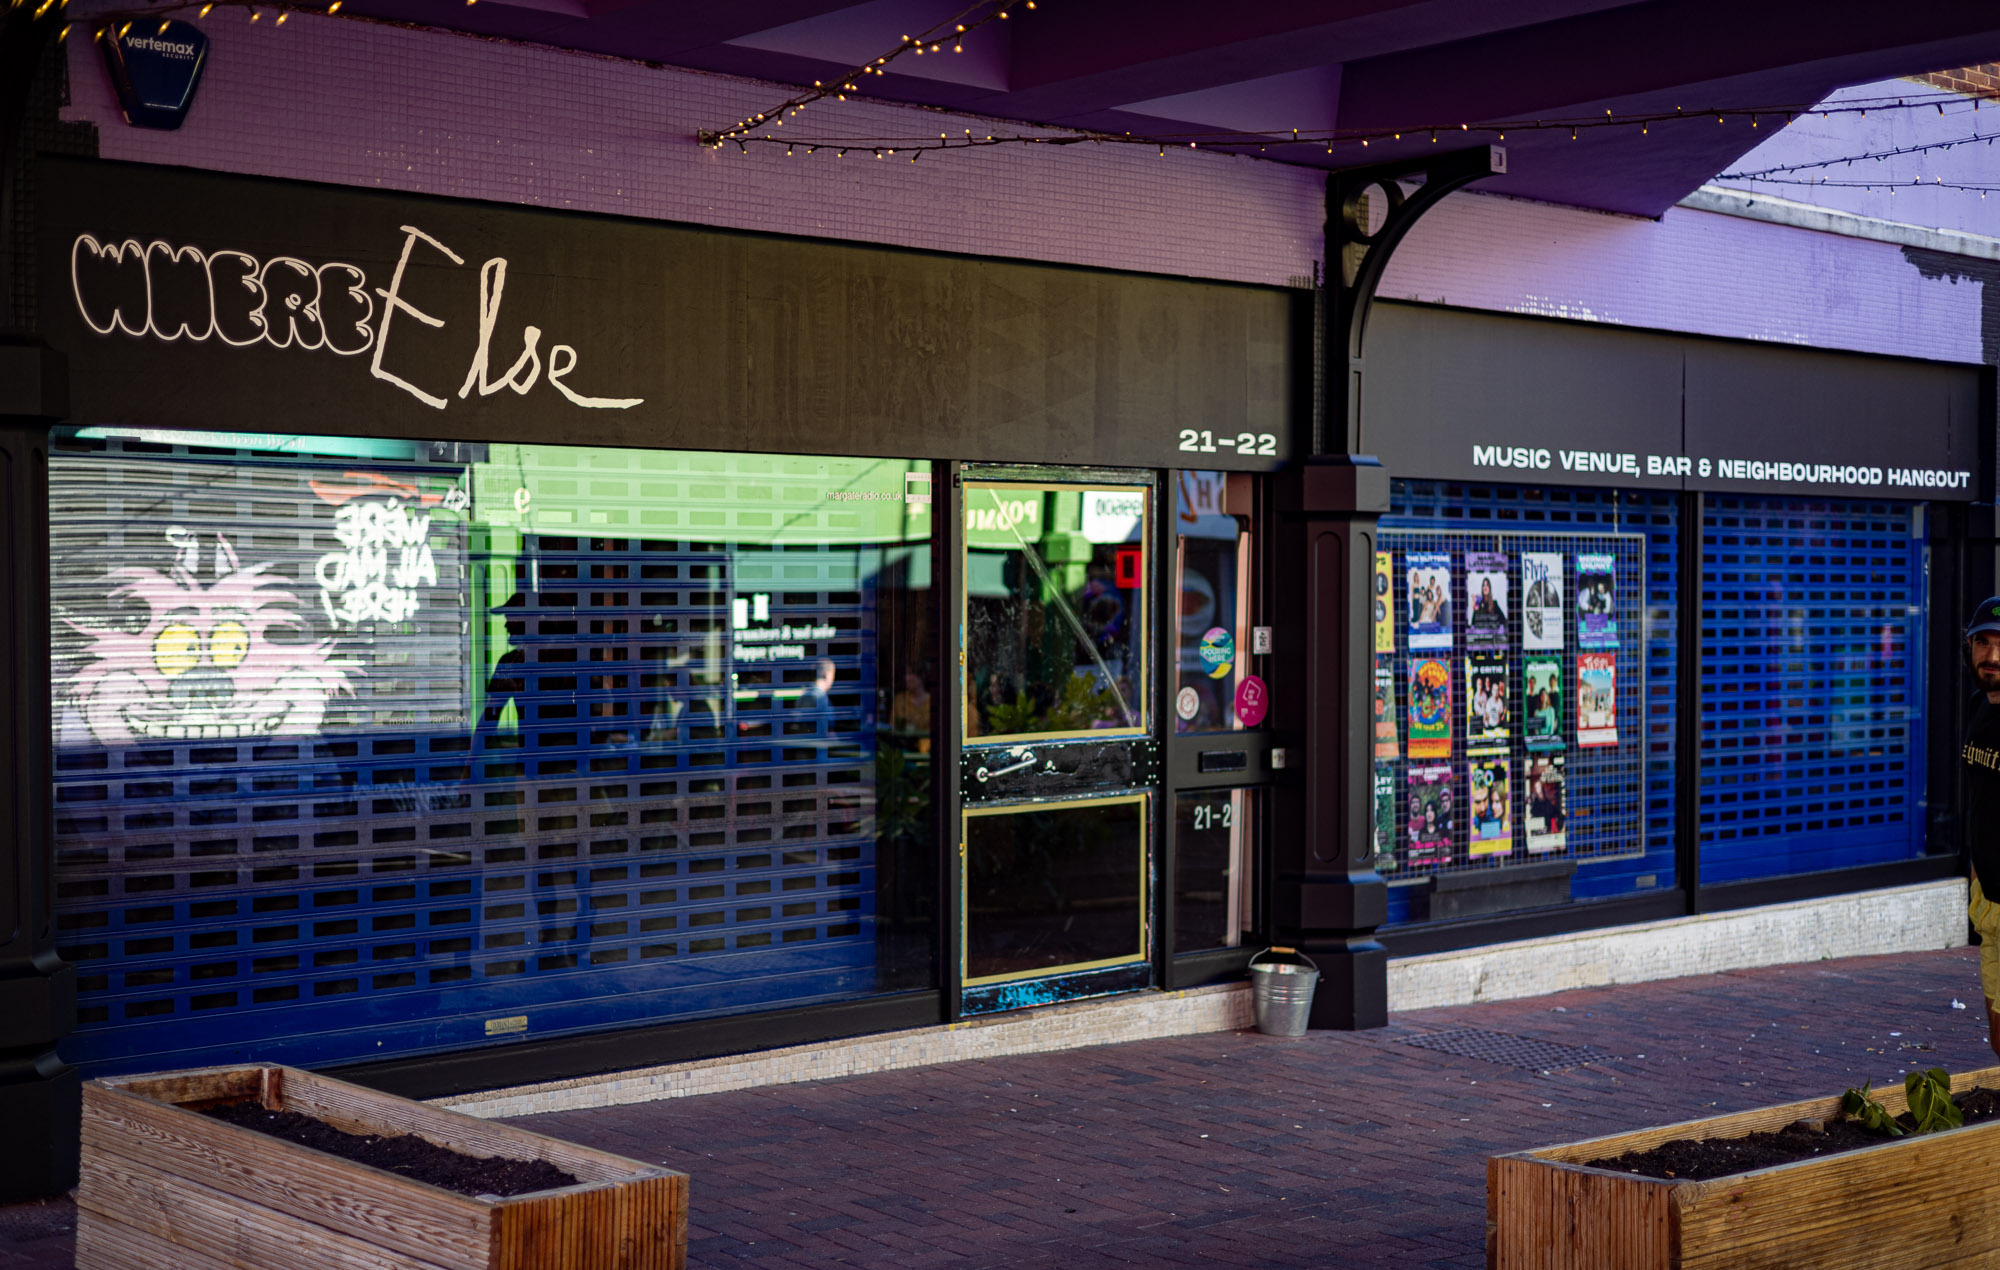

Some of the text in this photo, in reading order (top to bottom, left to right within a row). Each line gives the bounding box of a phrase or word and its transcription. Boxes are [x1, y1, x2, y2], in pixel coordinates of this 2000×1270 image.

[126, 36, 194, 55] vertemax
[162, 53, 194, 61] SECURITY
[71, 225, 645, 410] WHERE Else
[1178, 429, 1277, 456] 21-22
[1473, 444, 1970, 488] MUSIC VENUE, BAR & NEIGHBOURHOOD HANGOUT
[826, 491, 903, 502] margateradio.co.uk
[1524, 559, 1549, 583] Flyte
